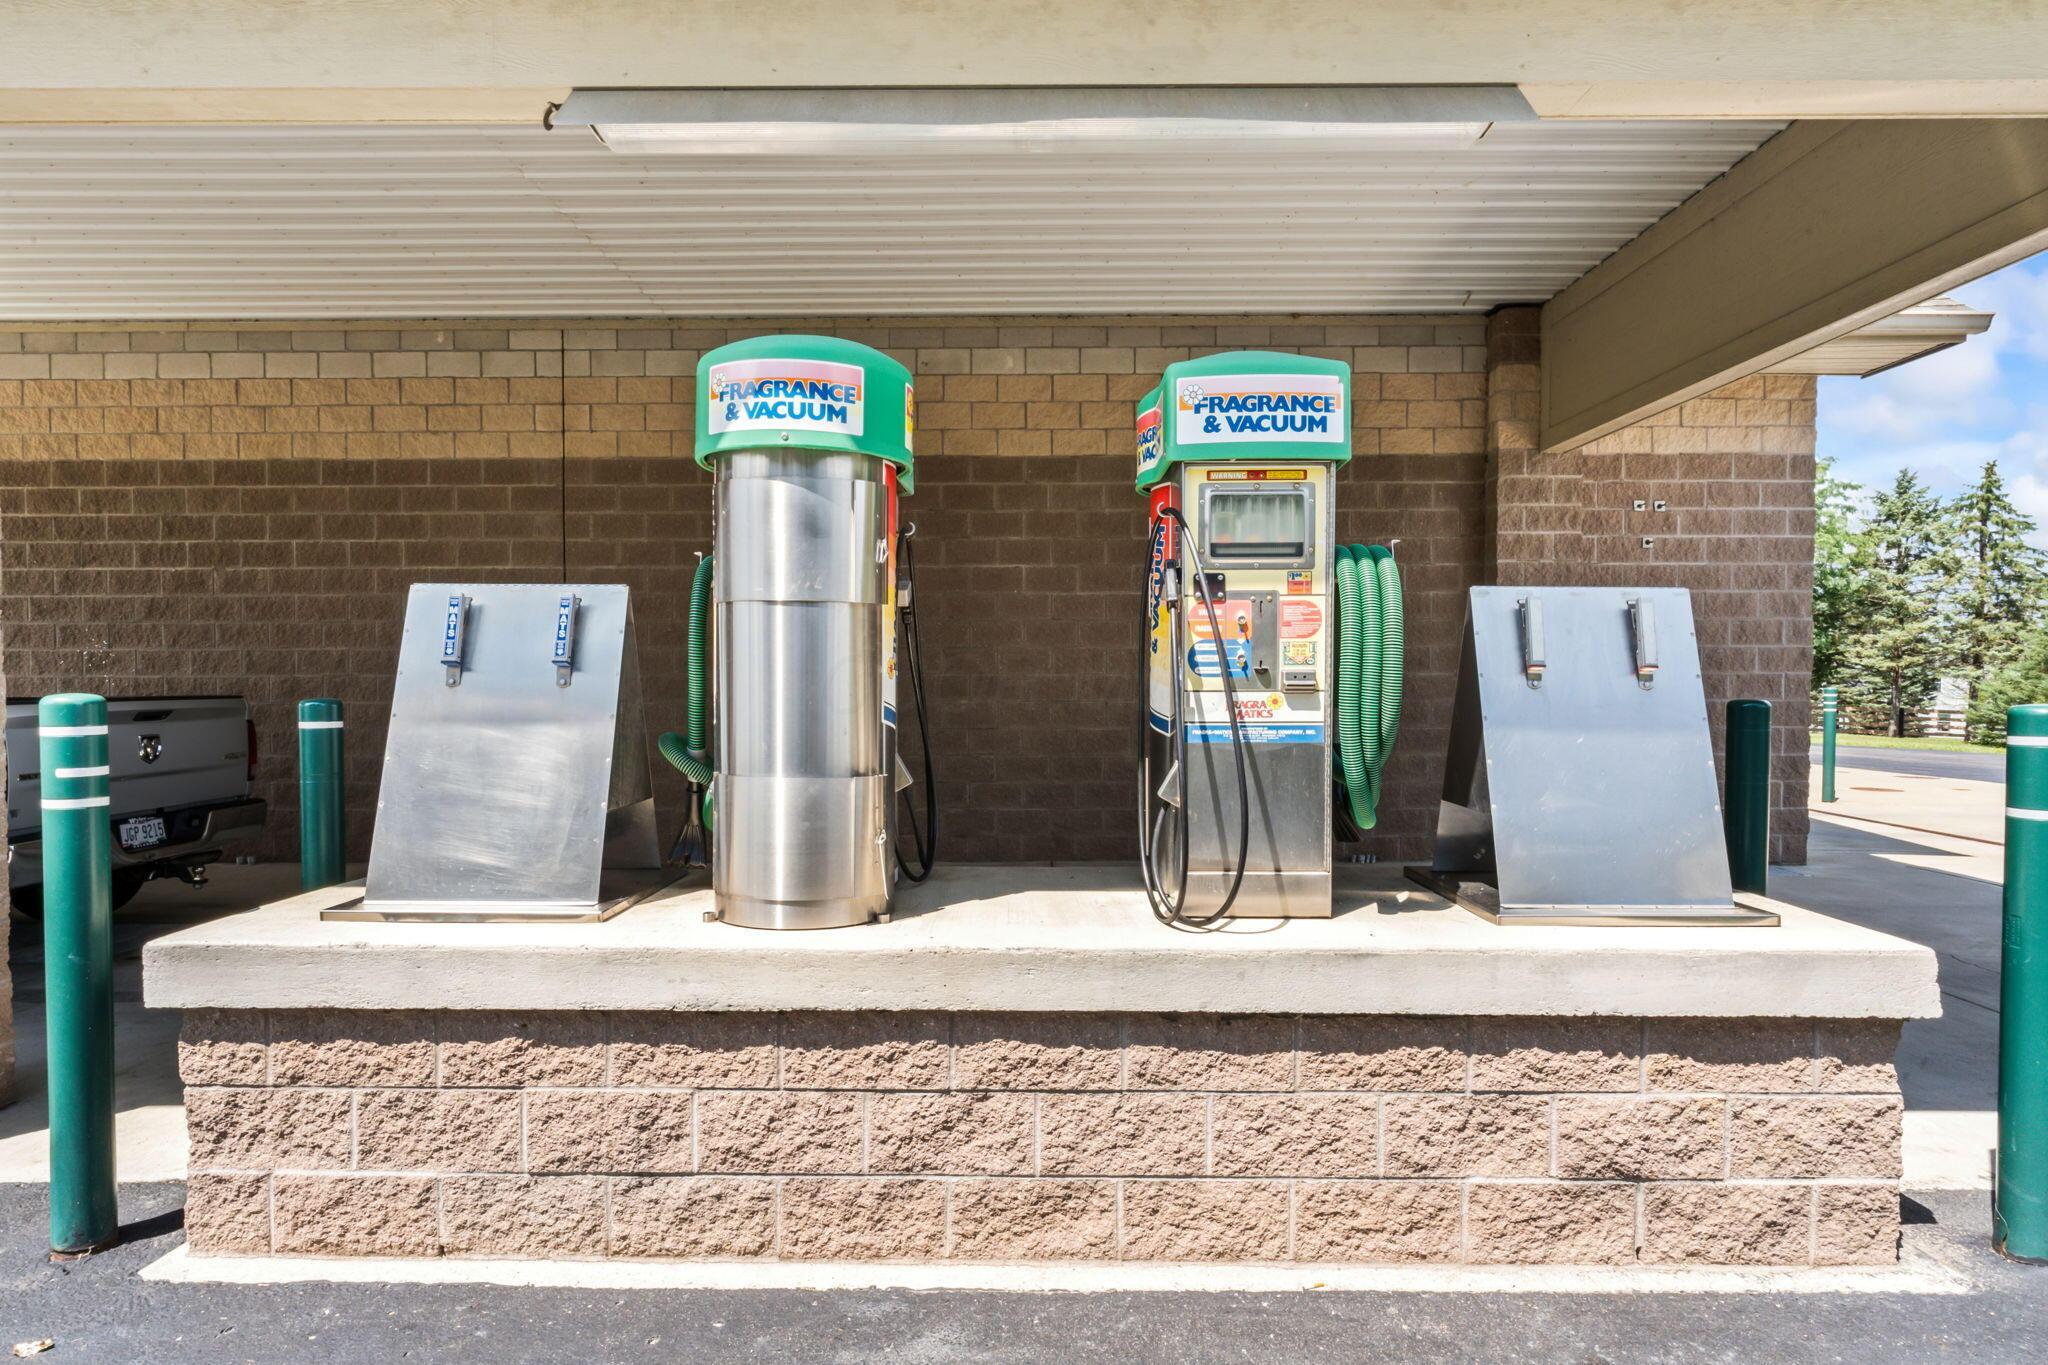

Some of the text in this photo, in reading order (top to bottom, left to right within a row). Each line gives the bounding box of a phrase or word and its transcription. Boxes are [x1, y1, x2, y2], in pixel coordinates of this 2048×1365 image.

[719, 379, 857, 404] FRAGRANCE
[725, 401, 848, 424] & VACUUM
[1194, 395, 1335, 414] FRAGRANCE
[1203, 414, 1328, 434] & VACUUM
[1210, 471, 1248, 480] WARNING
[447, 606, 458, 637] MATS
[558, 607, 569, 638] MATS
[124, 822, 164, 842] JGP 9215
